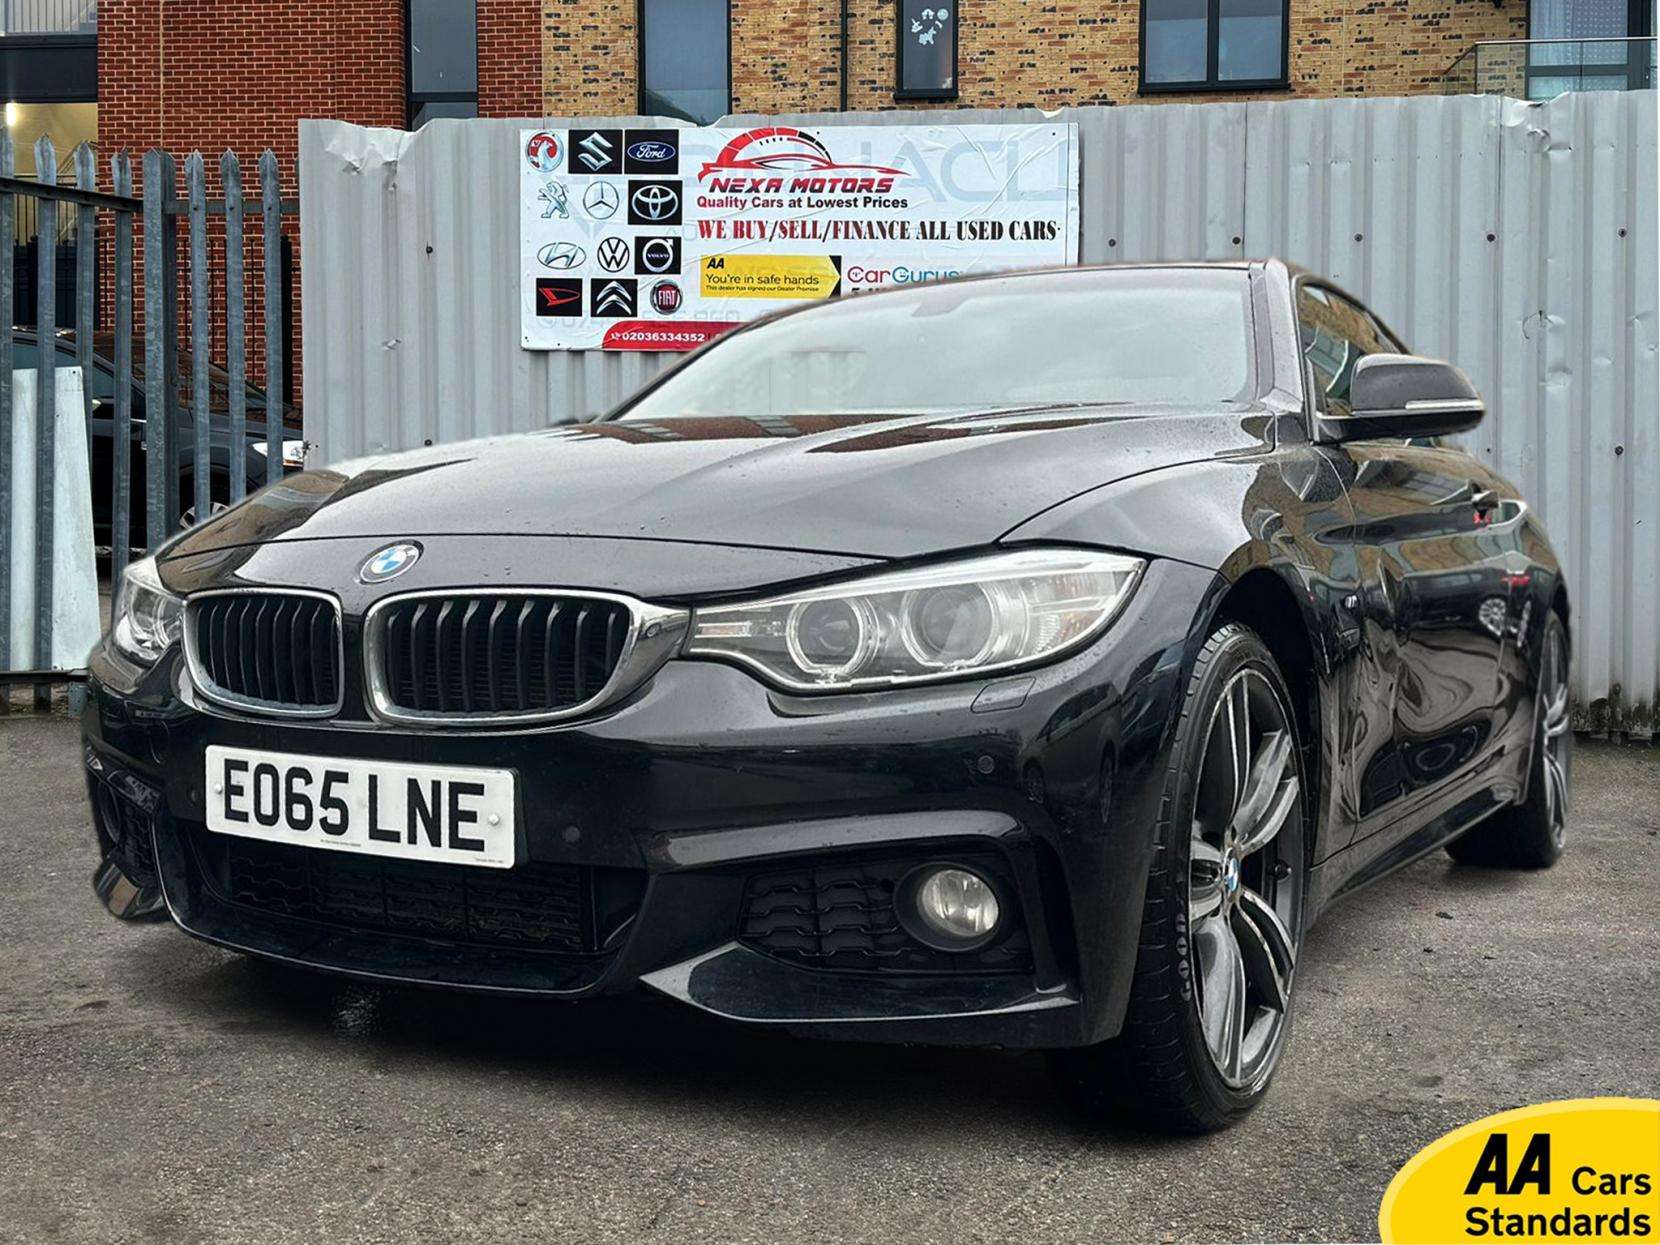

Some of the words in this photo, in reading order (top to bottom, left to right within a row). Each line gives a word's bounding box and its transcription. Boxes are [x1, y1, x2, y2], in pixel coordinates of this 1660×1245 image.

[636, 144, 666, 158] Ford
[709, 178, 783, 193] NEXA
[789, 178, 894, 193] MOTORS
[697, 196, 747, 210] Quality
[752, 197, 783, 208] Cars
[788, 198, 803, 208] at
[807, 197, 858, 209] Lowest
[863, 197, 908, 209] Prices
[698, 220, 727, 239] WE
[916, 221, 950, 240] ALL
[957, 221, 1004, 240] USED
[1009, 221, 1057, 240] CARS
[707, 258, 724, 269] AA
[706, 274, 741, 284] You're
[744, 275, 754, 284] in
[757, 274, 781, 285] safe
[784, 275, 819, 285] hands
[658, 290, 677, 306] FIAT
[622, 332, 705, 342] 02036334352
[224, 758, 349, 836] EO65
[368, 774, 485, 851] LNE
